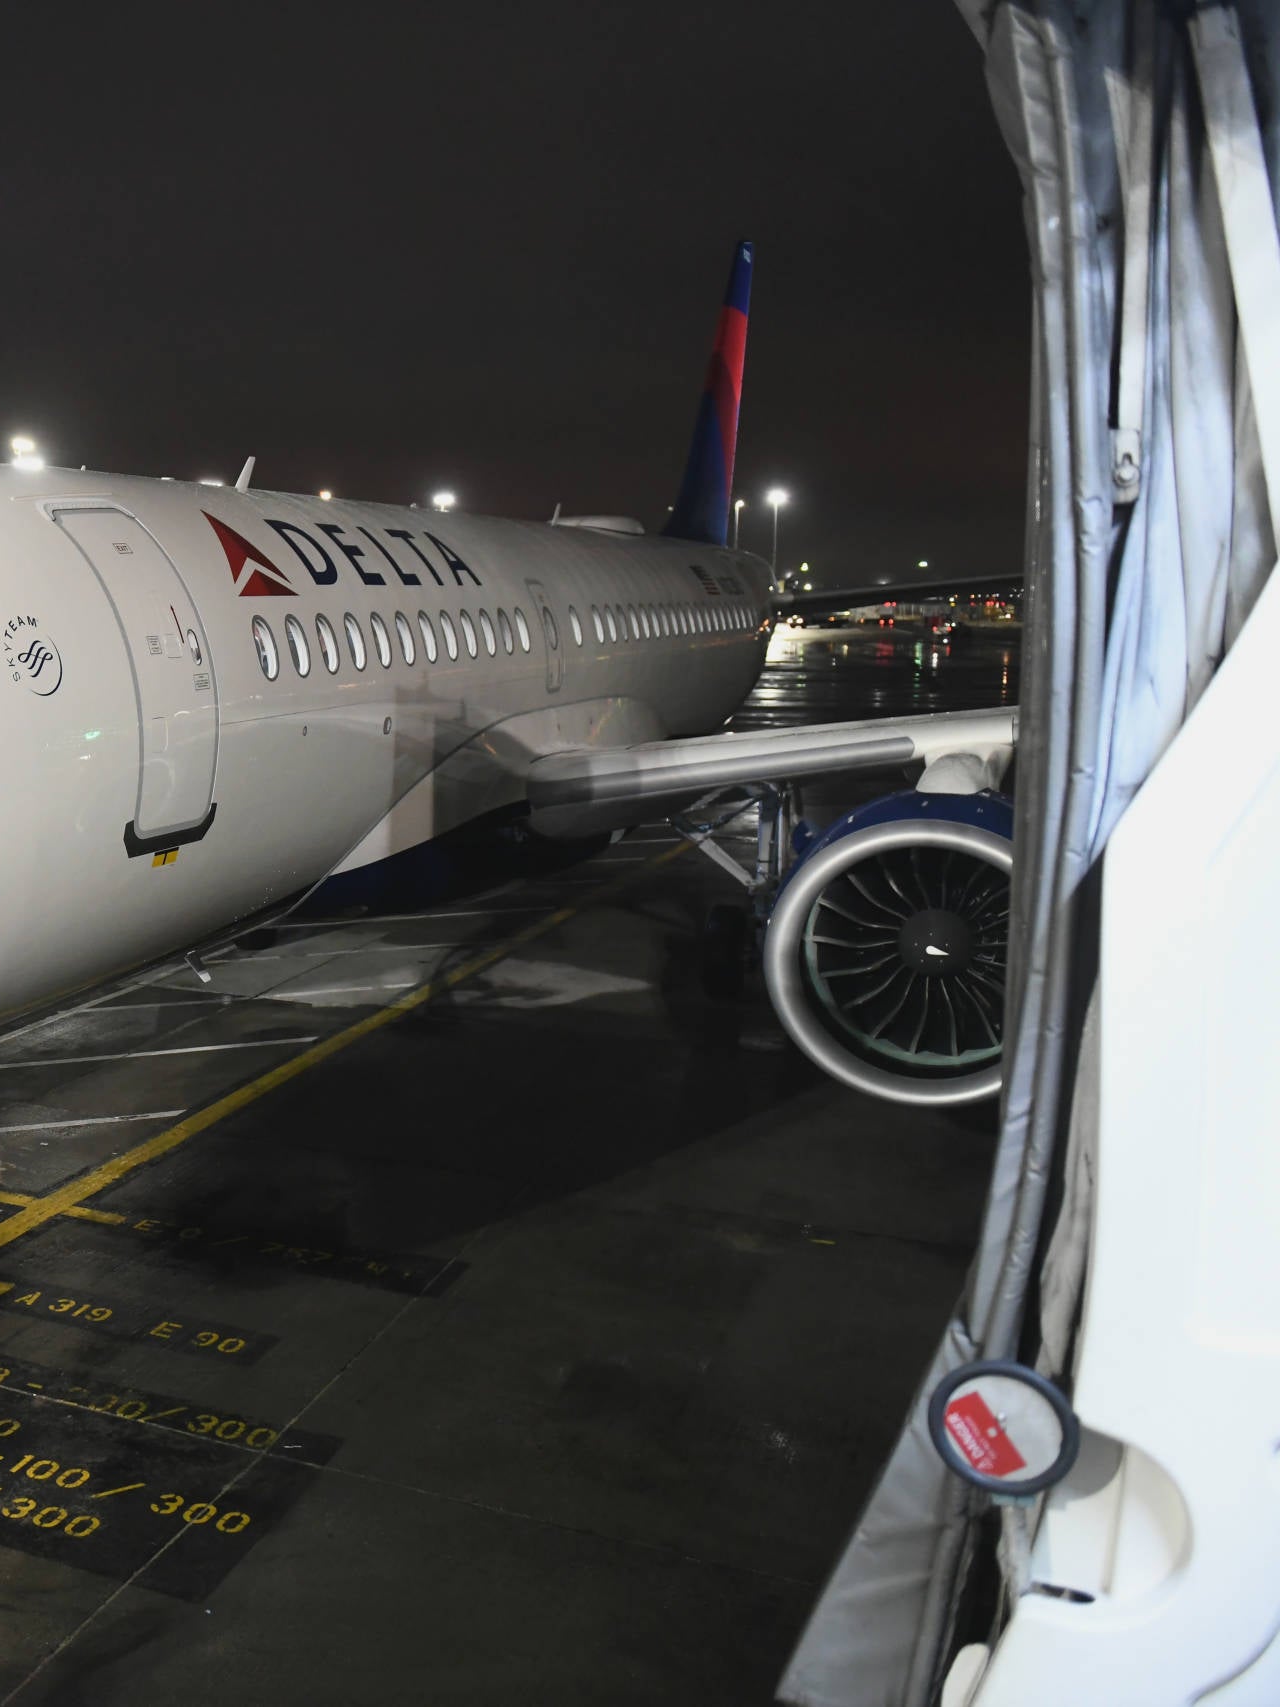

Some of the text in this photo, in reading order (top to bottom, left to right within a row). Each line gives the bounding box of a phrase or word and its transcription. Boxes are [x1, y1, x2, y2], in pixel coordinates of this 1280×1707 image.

[263, 518, 482, 586] DELTA
[3, 615, 38, 682] SKYTEAM
[14, 1291, 246, 1353] A 319 E 90
